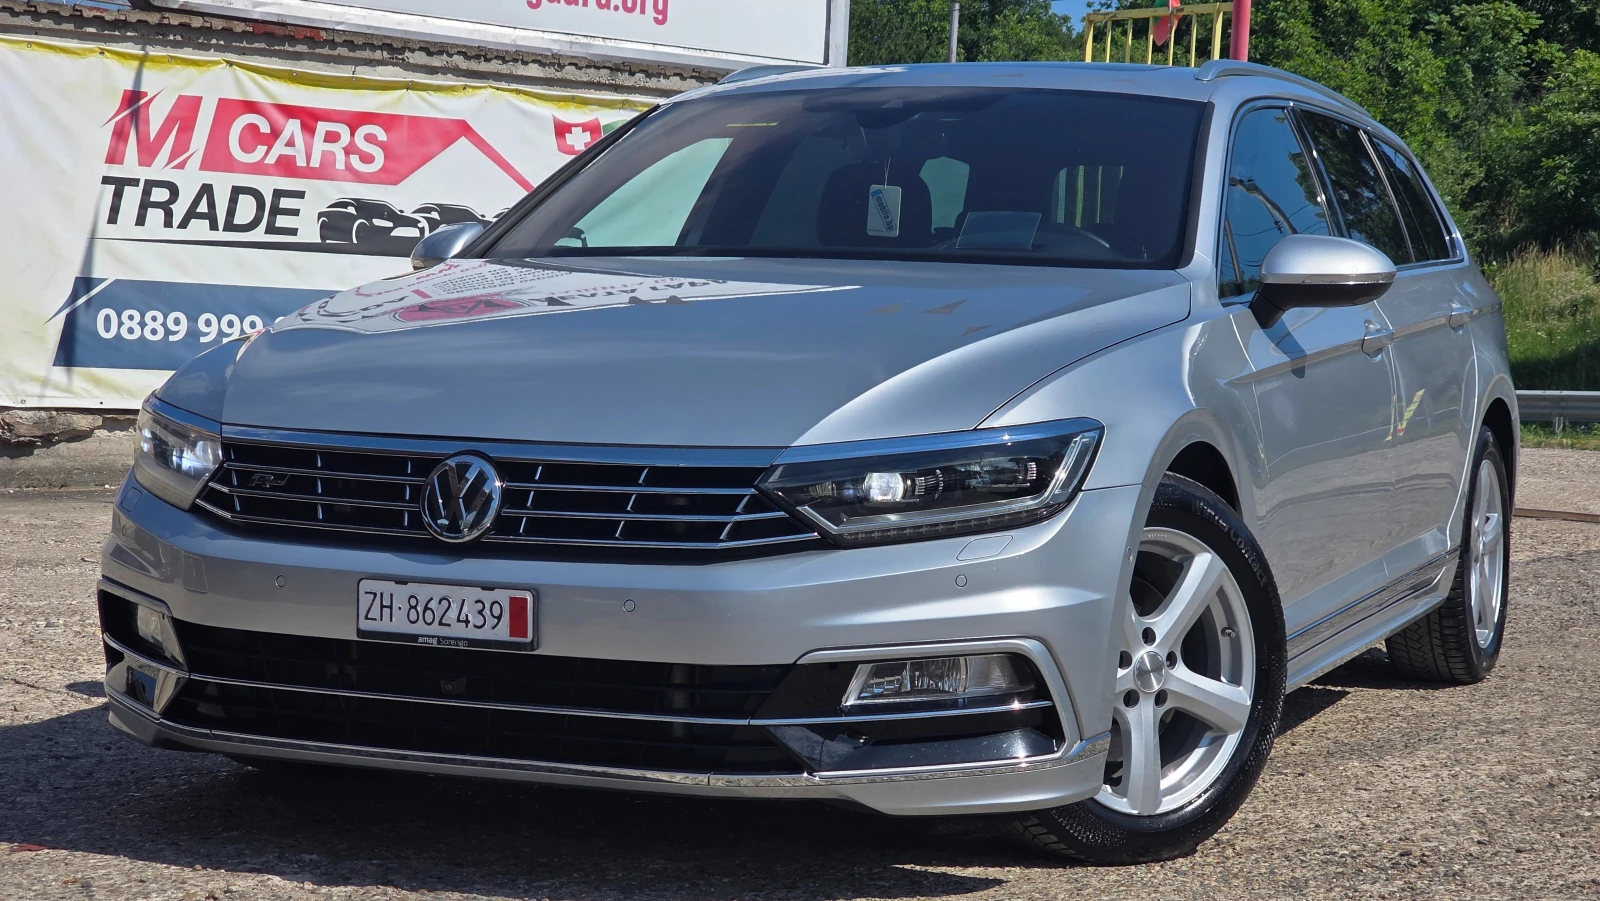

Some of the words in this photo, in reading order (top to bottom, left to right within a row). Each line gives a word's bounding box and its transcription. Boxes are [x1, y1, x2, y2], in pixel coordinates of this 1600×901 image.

[101, 87, 203, 171] M
[229, 113, 388, 173] CARS
[101, 175, 306, 237] TRADE
[96, 308, 188, 342] 0889
[417, 635, 438, 646] amag
[439, 637, 468, 648] Sorengo
